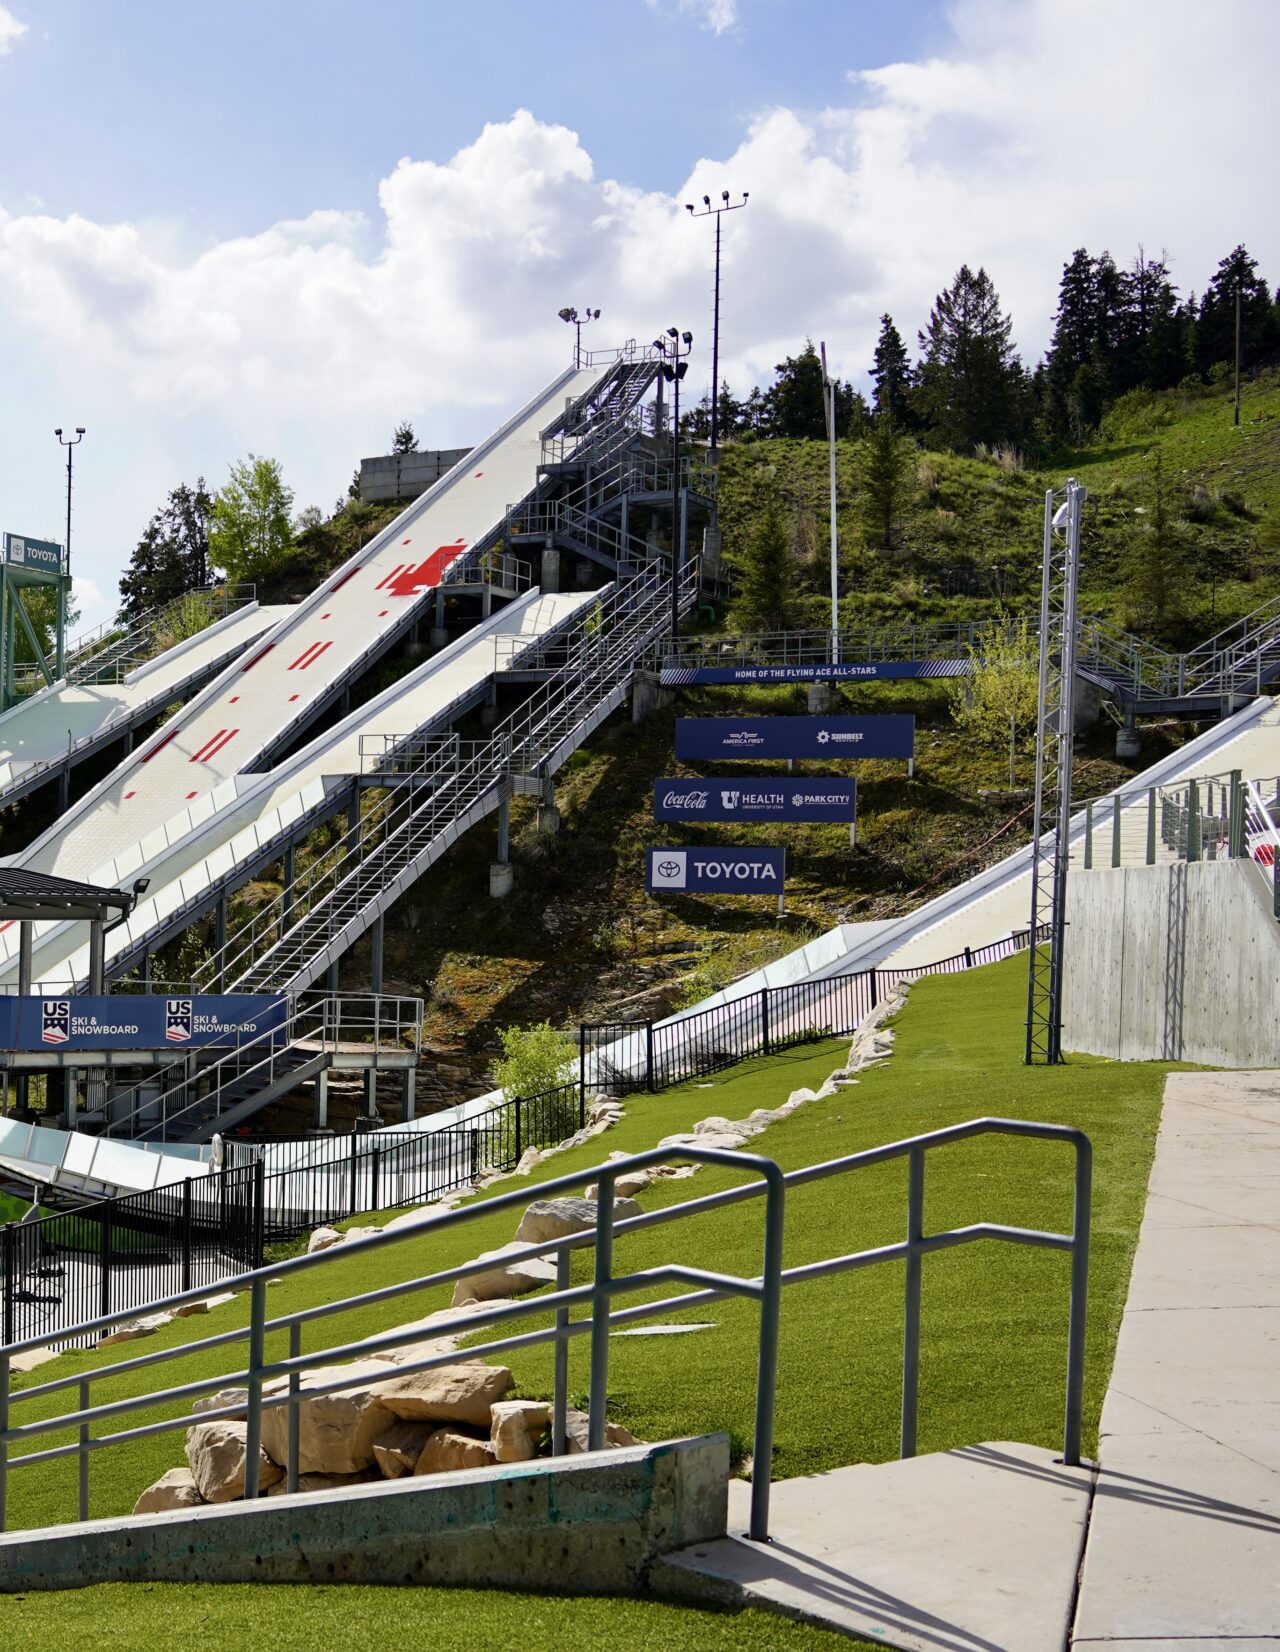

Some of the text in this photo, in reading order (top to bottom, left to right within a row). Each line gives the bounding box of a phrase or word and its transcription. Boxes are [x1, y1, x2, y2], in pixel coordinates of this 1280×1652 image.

[26, 547, 58, 563] TOYOTA
[787, 669, 814, 677] FLYING
[816, 668, 831, 676] ACE
[832, 667, 877, 675] ALL-STARS
[663, 791, 710, 809] Coca-Cola
[742, 794, 784, 804] HEALTH
[804, 795, 845, 803] PARK CITY
[694, 862, 776, 879] TOYOTA
[44, 1002, 68, 1016] US
[168, 1001, 191, 1015] US
[71, 1017, 97, 1025] SKI &
[193, 1015, 218, 1023] SKI &
[71, 1025, 139, 1034] SNOWBOARD
[193, 1024, 257, 1032] SNOWBOARD
